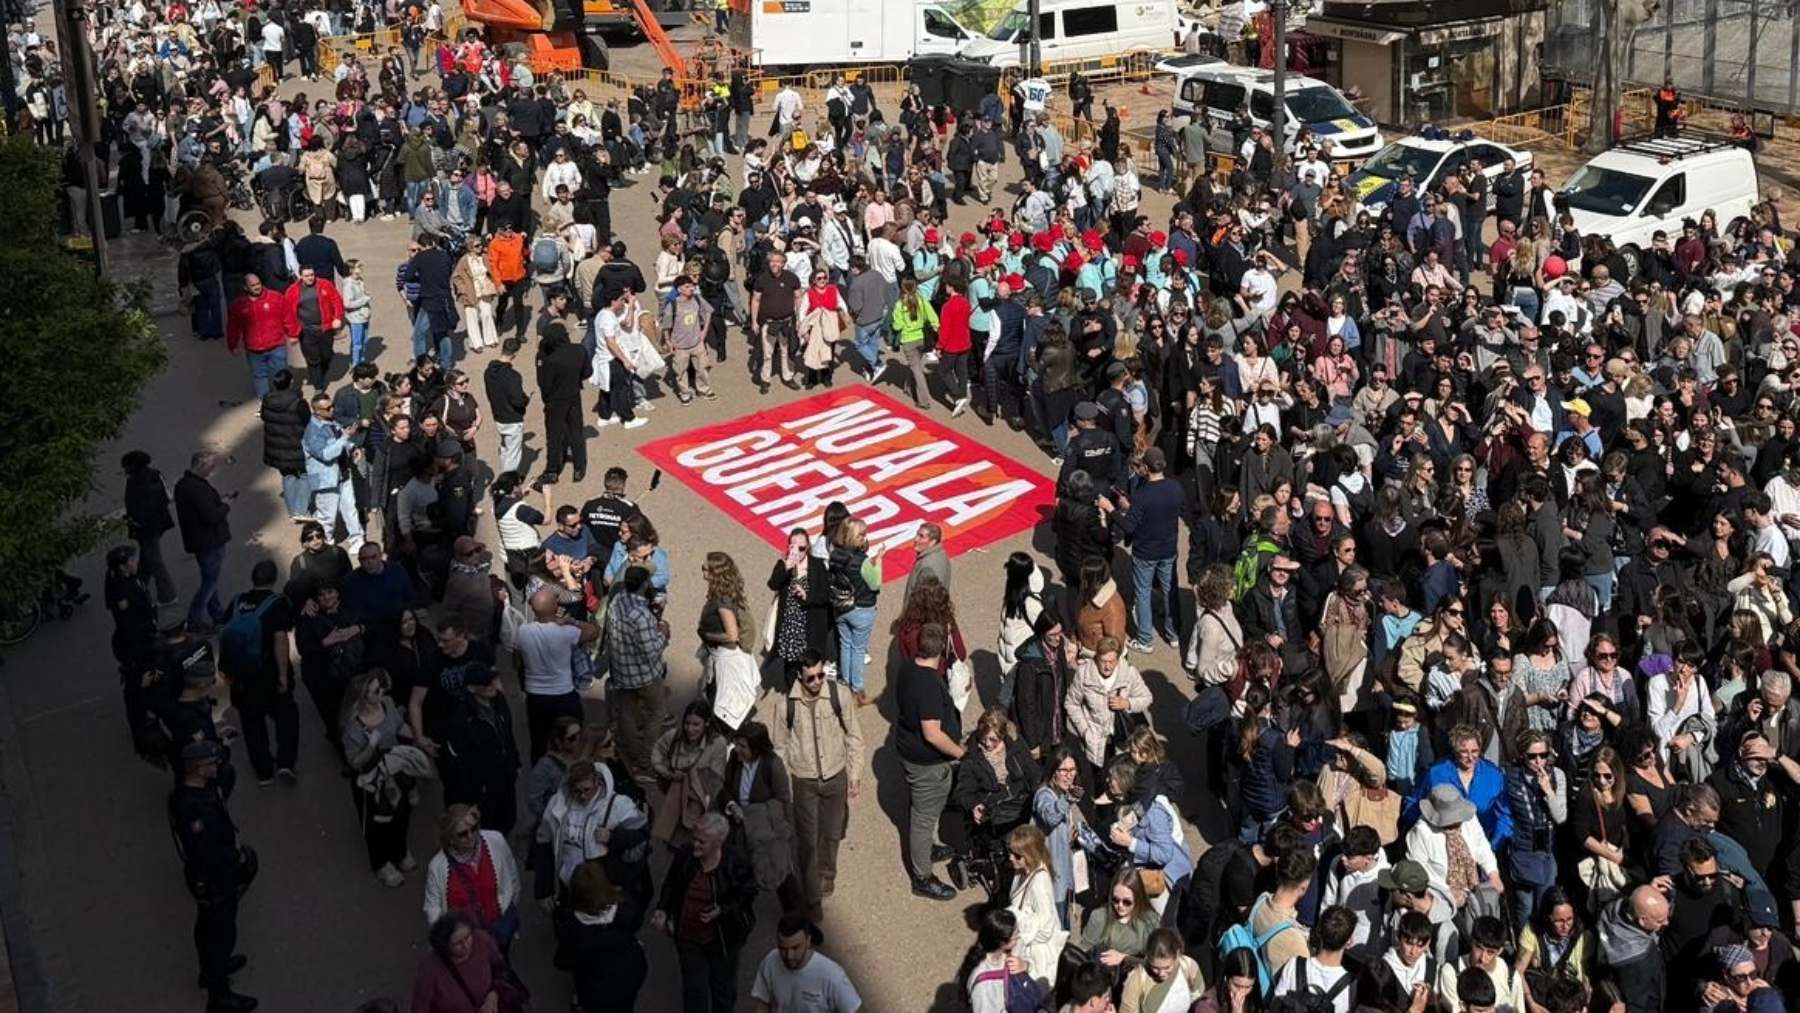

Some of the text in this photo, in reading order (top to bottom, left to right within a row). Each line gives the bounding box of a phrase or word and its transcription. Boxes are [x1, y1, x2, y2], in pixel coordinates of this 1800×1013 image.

[675, 429, 928, 556] GUERRA
[780, 399, 1037, 527] NO A LA
